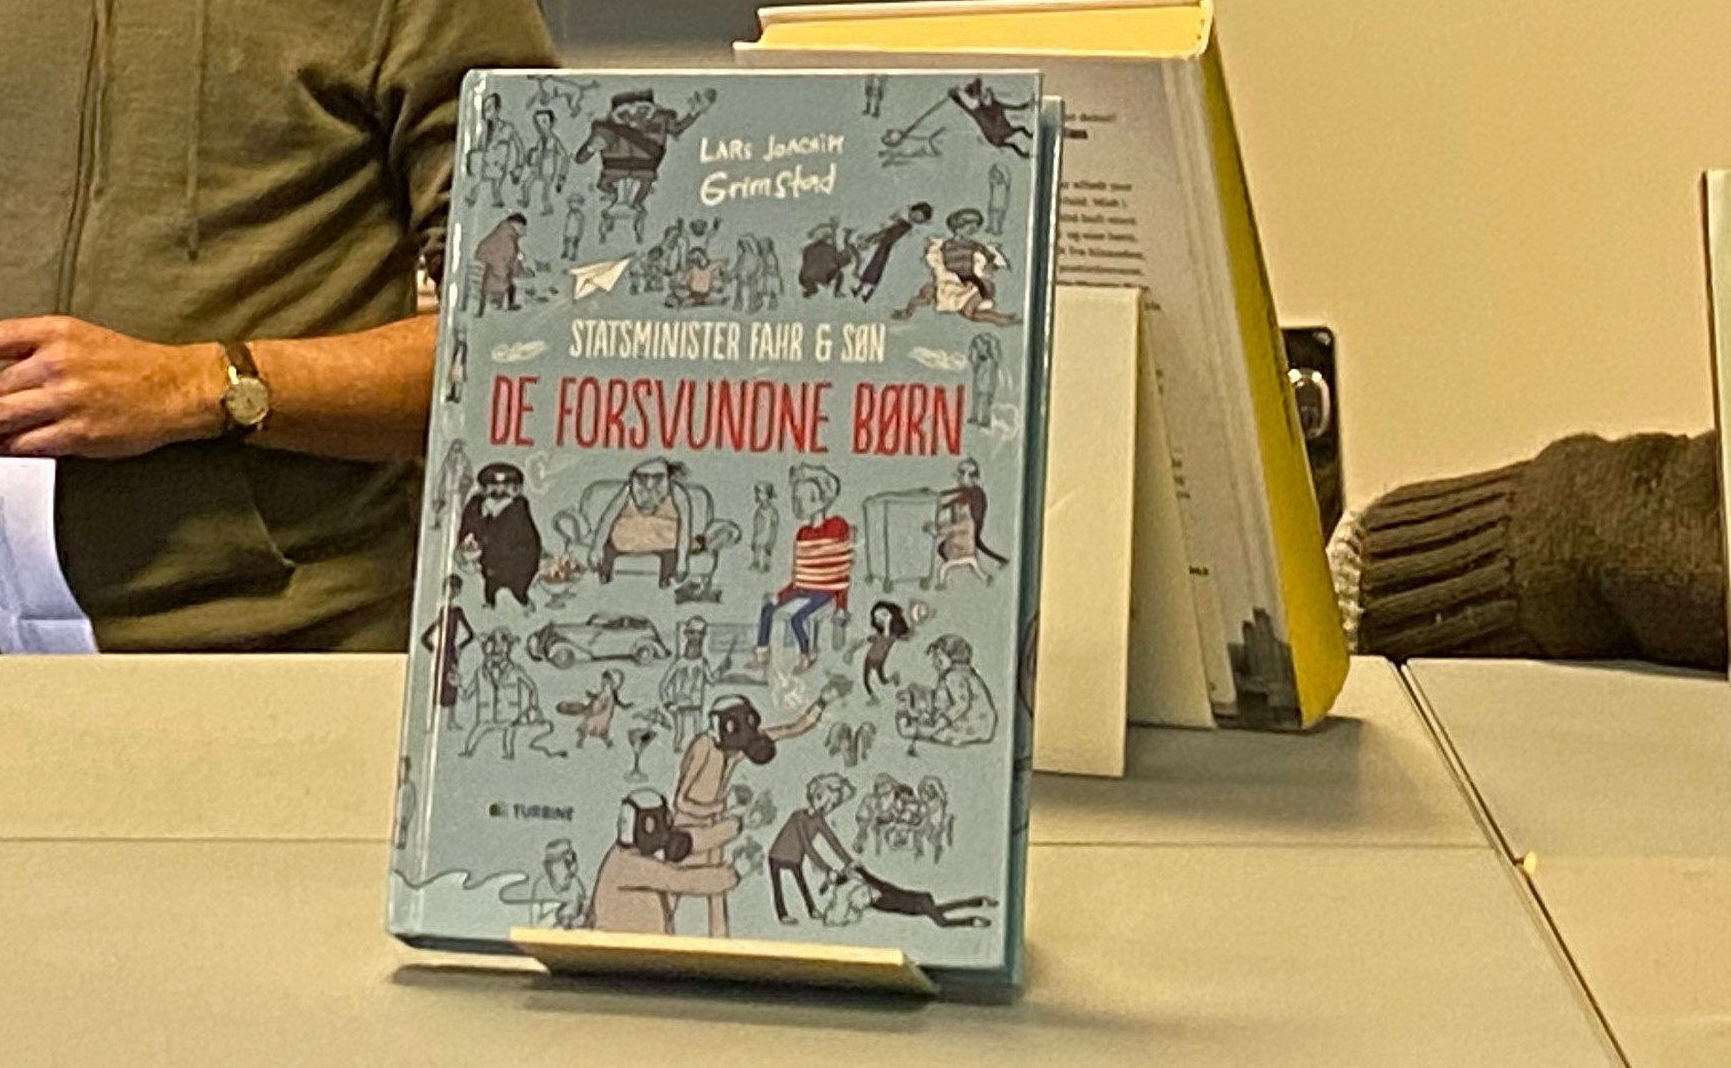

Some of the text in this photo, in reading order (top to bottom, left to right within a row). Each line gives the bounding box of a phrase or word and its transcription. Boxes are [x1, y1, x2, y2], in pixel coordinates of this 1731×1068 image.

[569, 318, 740, 361] STATSMINISTER
[749, 322, 804, 361] FAHR
[840, 323, 886, 363] SØN
[489, 374, 966, 457] DE FORSVUNDNE BØRN
